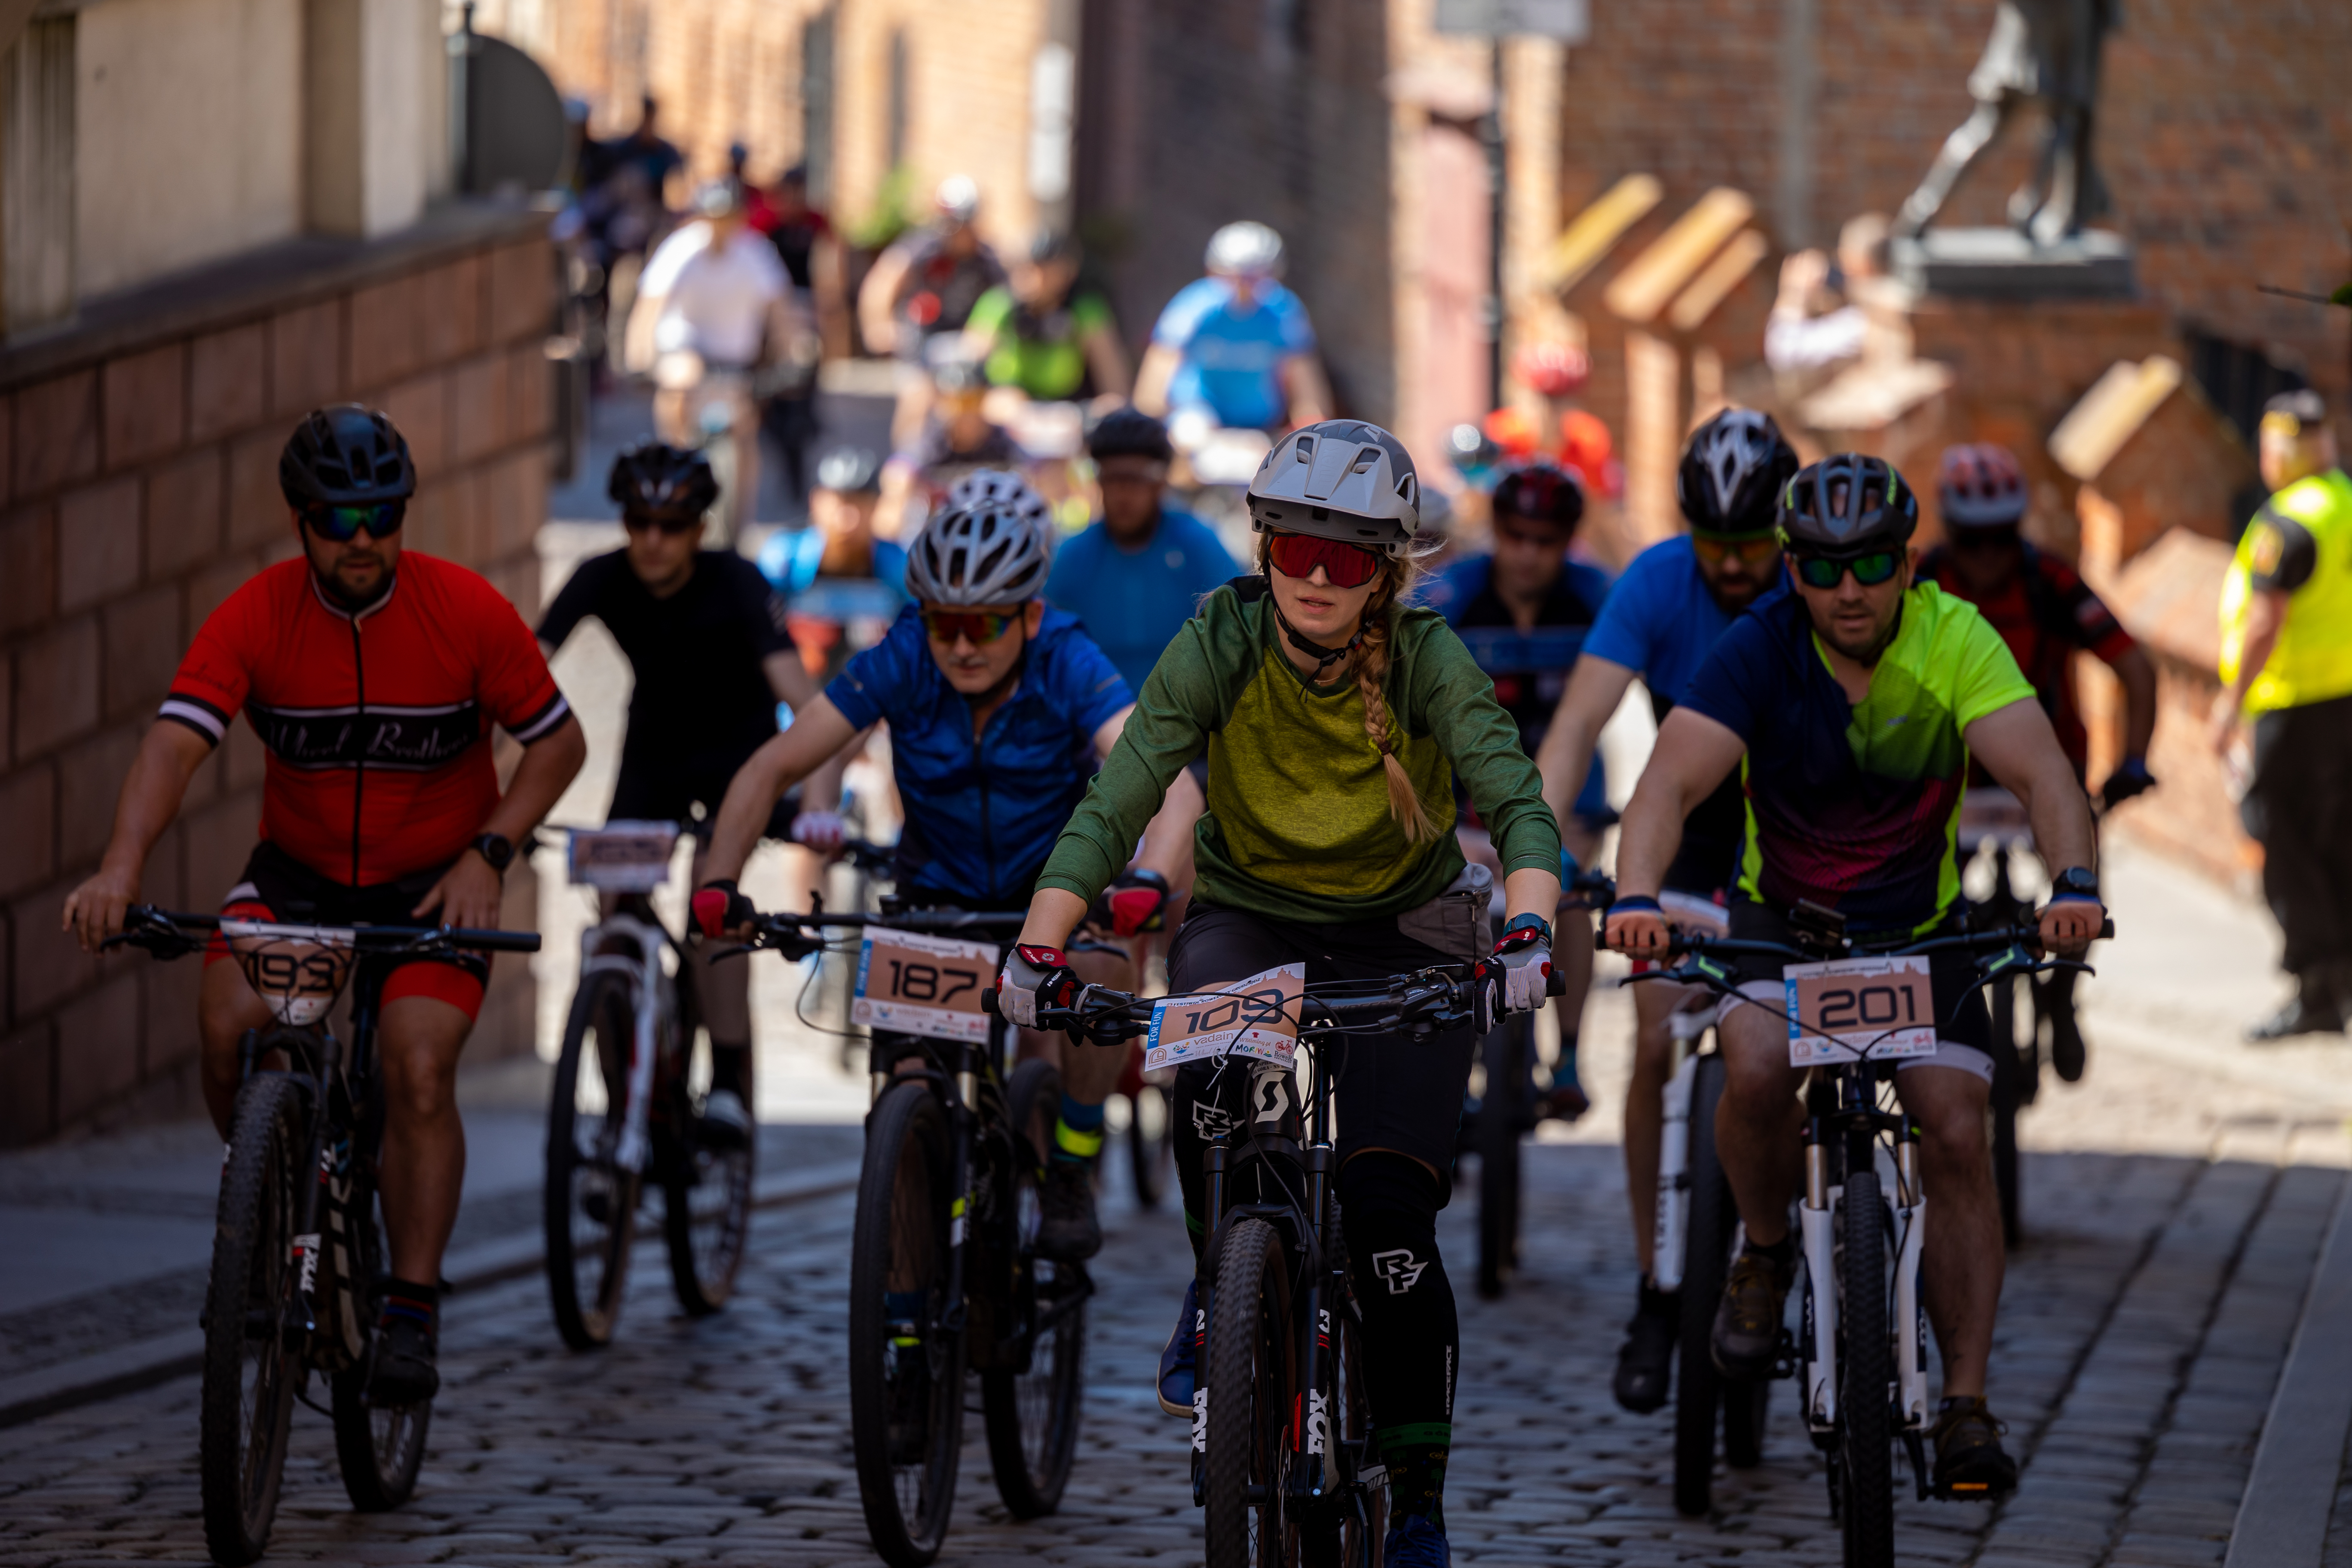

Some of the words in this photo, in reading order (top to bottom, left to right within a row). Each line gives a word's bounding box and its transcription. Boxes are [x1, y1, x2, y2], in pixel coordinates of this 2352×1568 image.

[249, 952, 335, 991] 193
[889, 959, 978, 1003] 187
[1152, 1012, 1163, 1025] FUN
[1185, 989, 1284, 1034] 109
[1818, 985, 1915, 1028] 201
[1149, 1026, 1159, 1042] FOR
[1194, 1032, 1233, 1045] vadain
[1192, 1387, 1208, 1453] FOX
[1308, 1389, 1329, 1455] FOX
